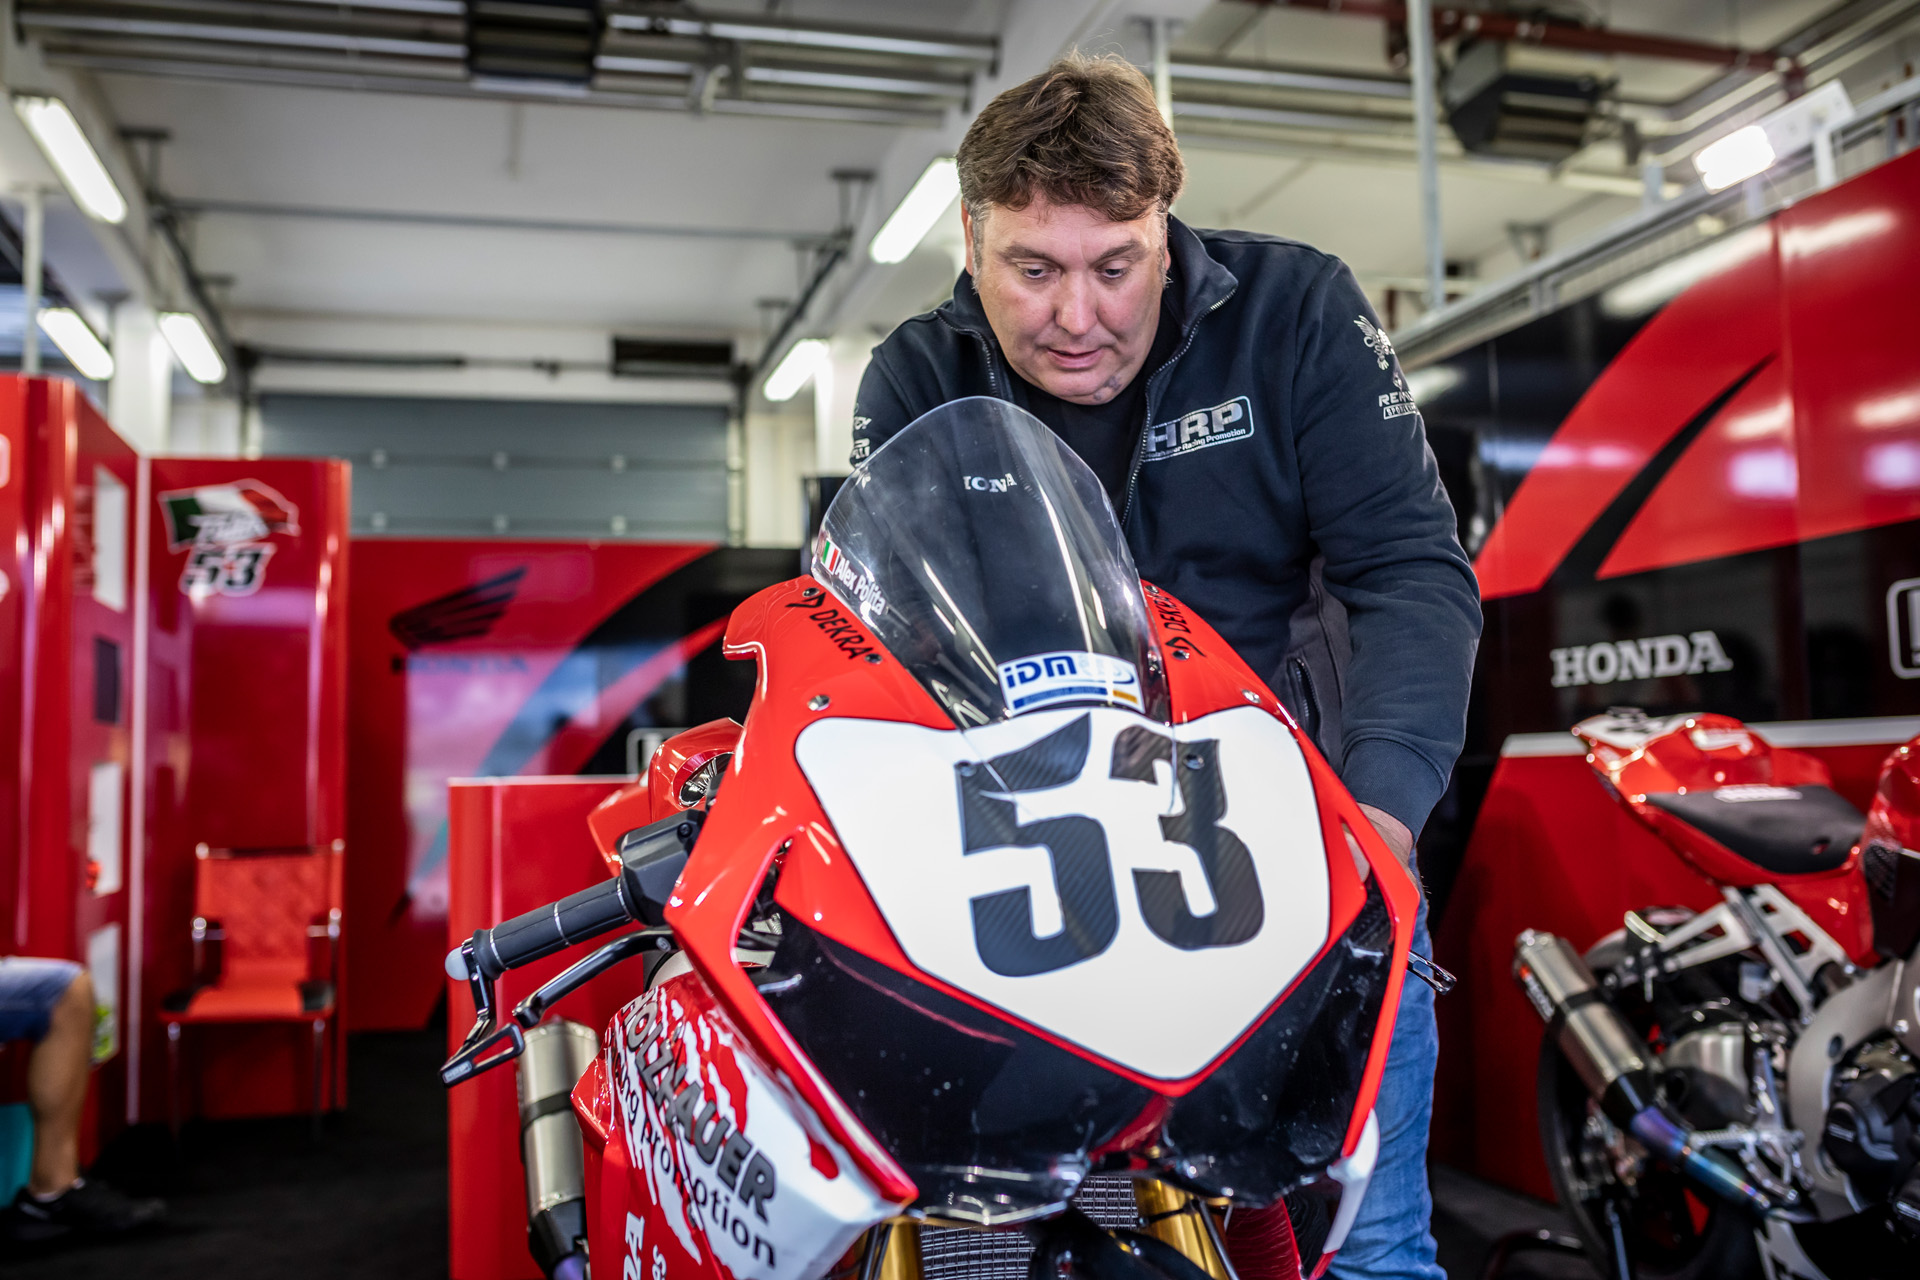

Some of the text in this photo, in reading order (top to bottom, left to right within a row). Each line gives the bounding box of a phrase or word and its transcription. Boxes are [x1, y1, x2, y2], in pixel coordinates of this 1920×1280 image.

[1147, 402, 1243, 452] HRP
[1206, 428, 1246, 443] Promotion
[184, 550, 264, 591] 53
[835, 558, 886, 616] Alex Polita
[809, 609, 874, 660] DEKRA
[1551, 631, 1733, 688] HONDA
[954, 712, 1264, 978] 53
